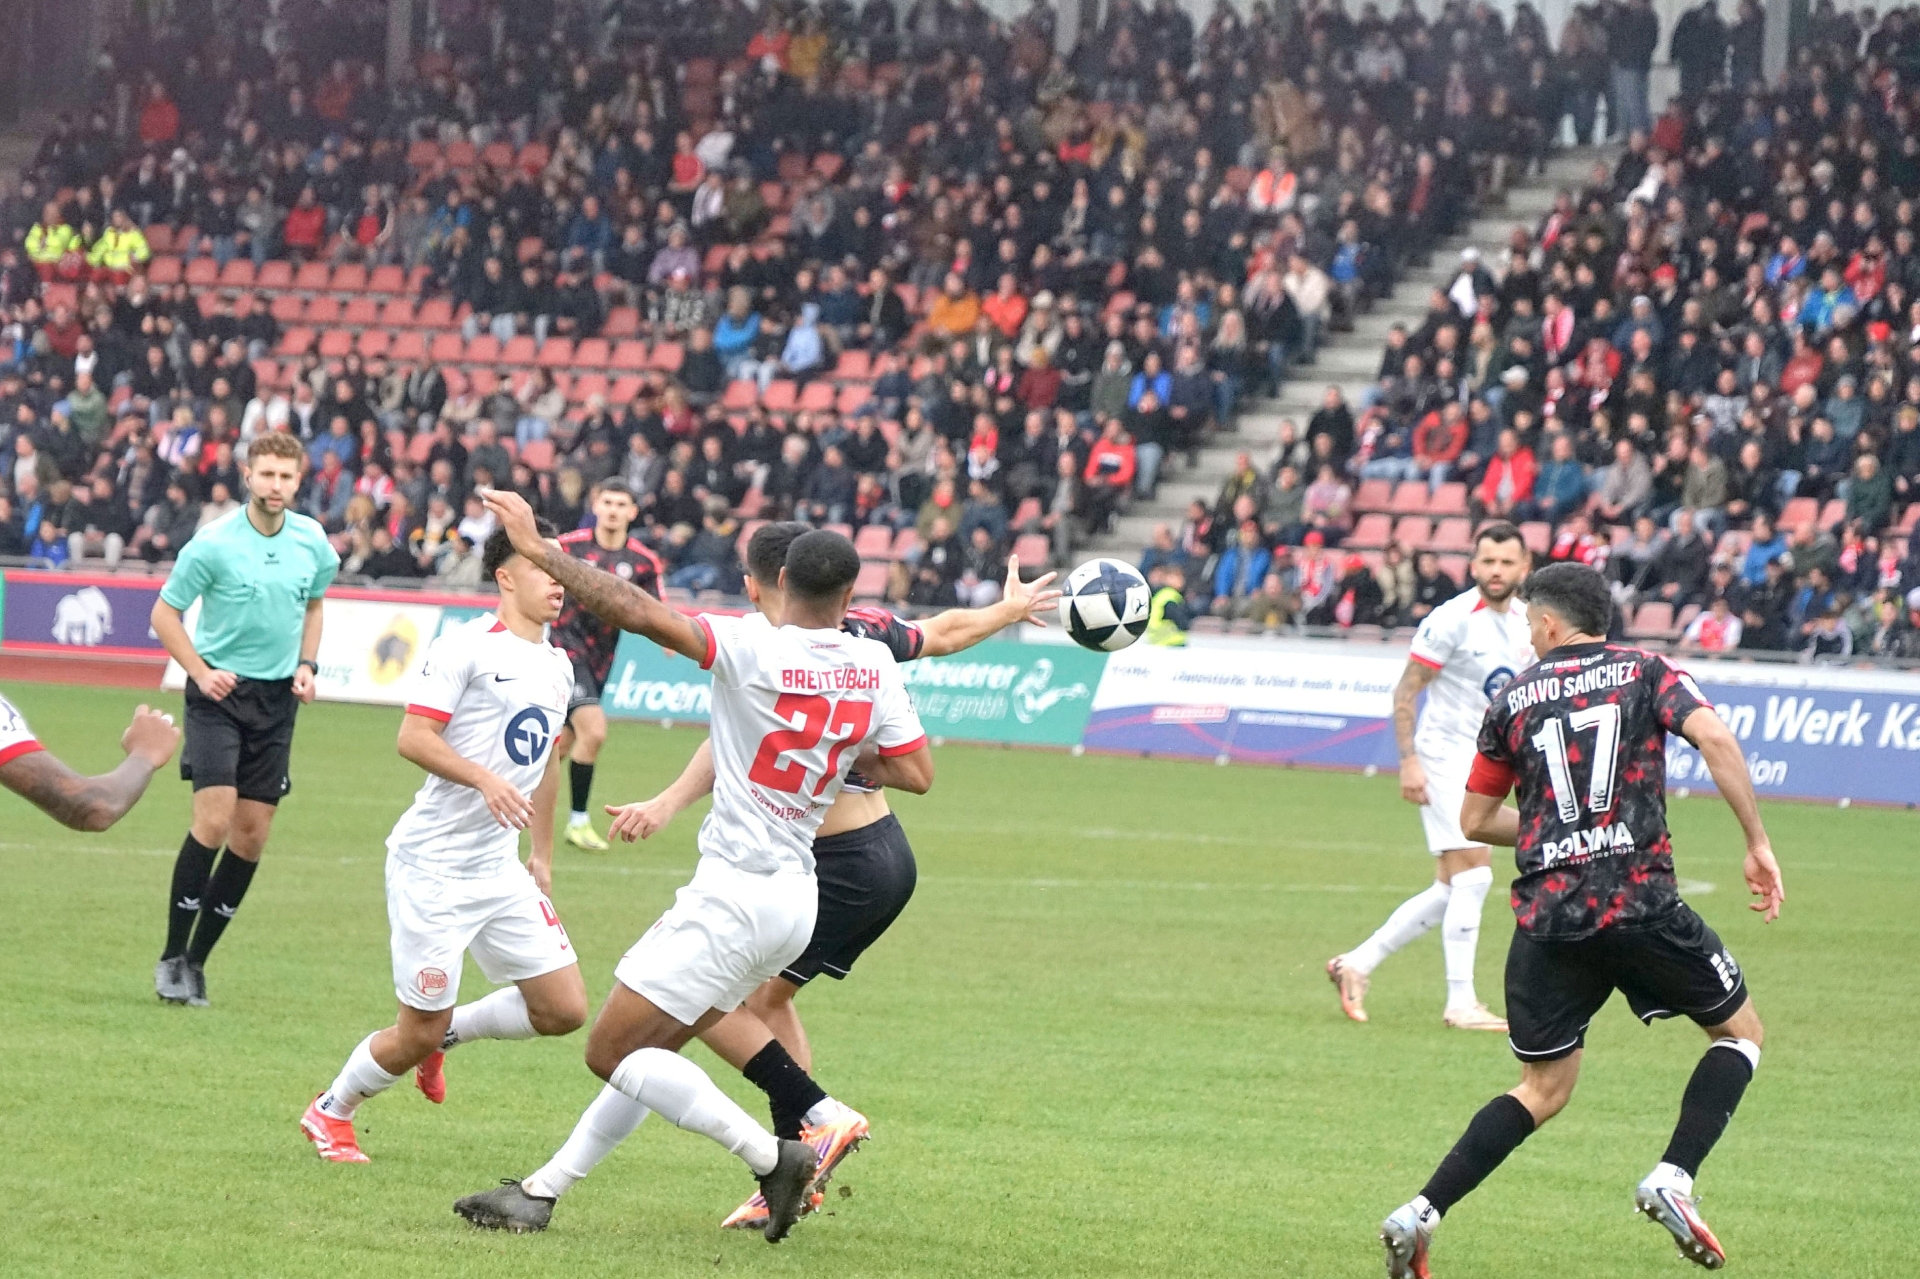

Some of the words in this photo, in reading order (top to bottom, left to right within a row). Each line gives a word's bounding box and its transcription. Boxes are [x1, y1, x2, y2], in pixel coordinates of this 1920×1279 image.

[1507, 677, 1560, 715] BRAVO
[1563, 661, 1636, 698] SANCHEZ
[747, 692, 874, 798] 27
[1763, 695, 1872, 747] Werk
[1531, 703, 1622, 825] 17
[1542, 822, 1635, 868] POLYMA
